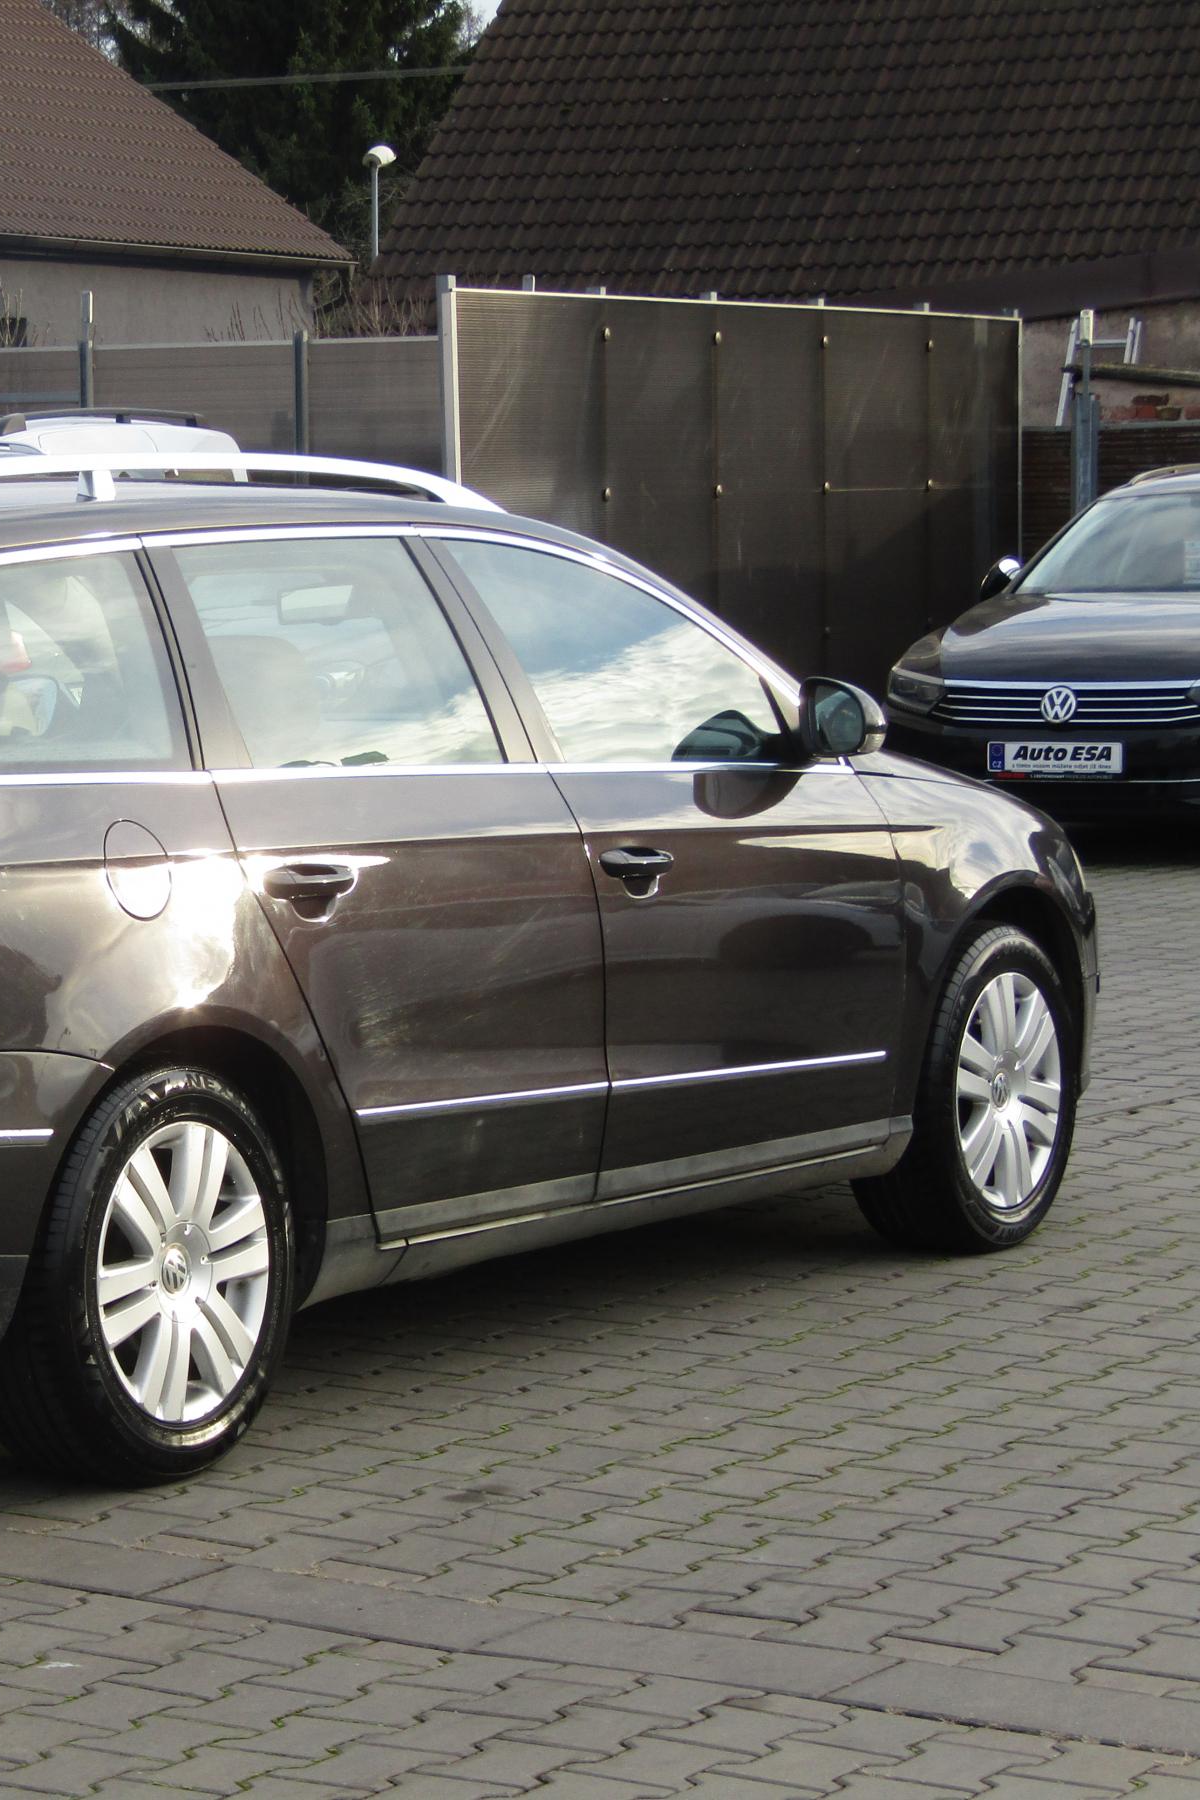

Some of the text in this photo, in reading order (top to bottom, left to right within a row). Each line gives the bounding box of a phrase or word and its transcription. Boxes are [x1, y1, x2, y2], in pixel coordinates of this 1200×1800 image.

[1013, 746, 1112, 761] Auto ESA
[991, 760, 1002, 769] CZ
